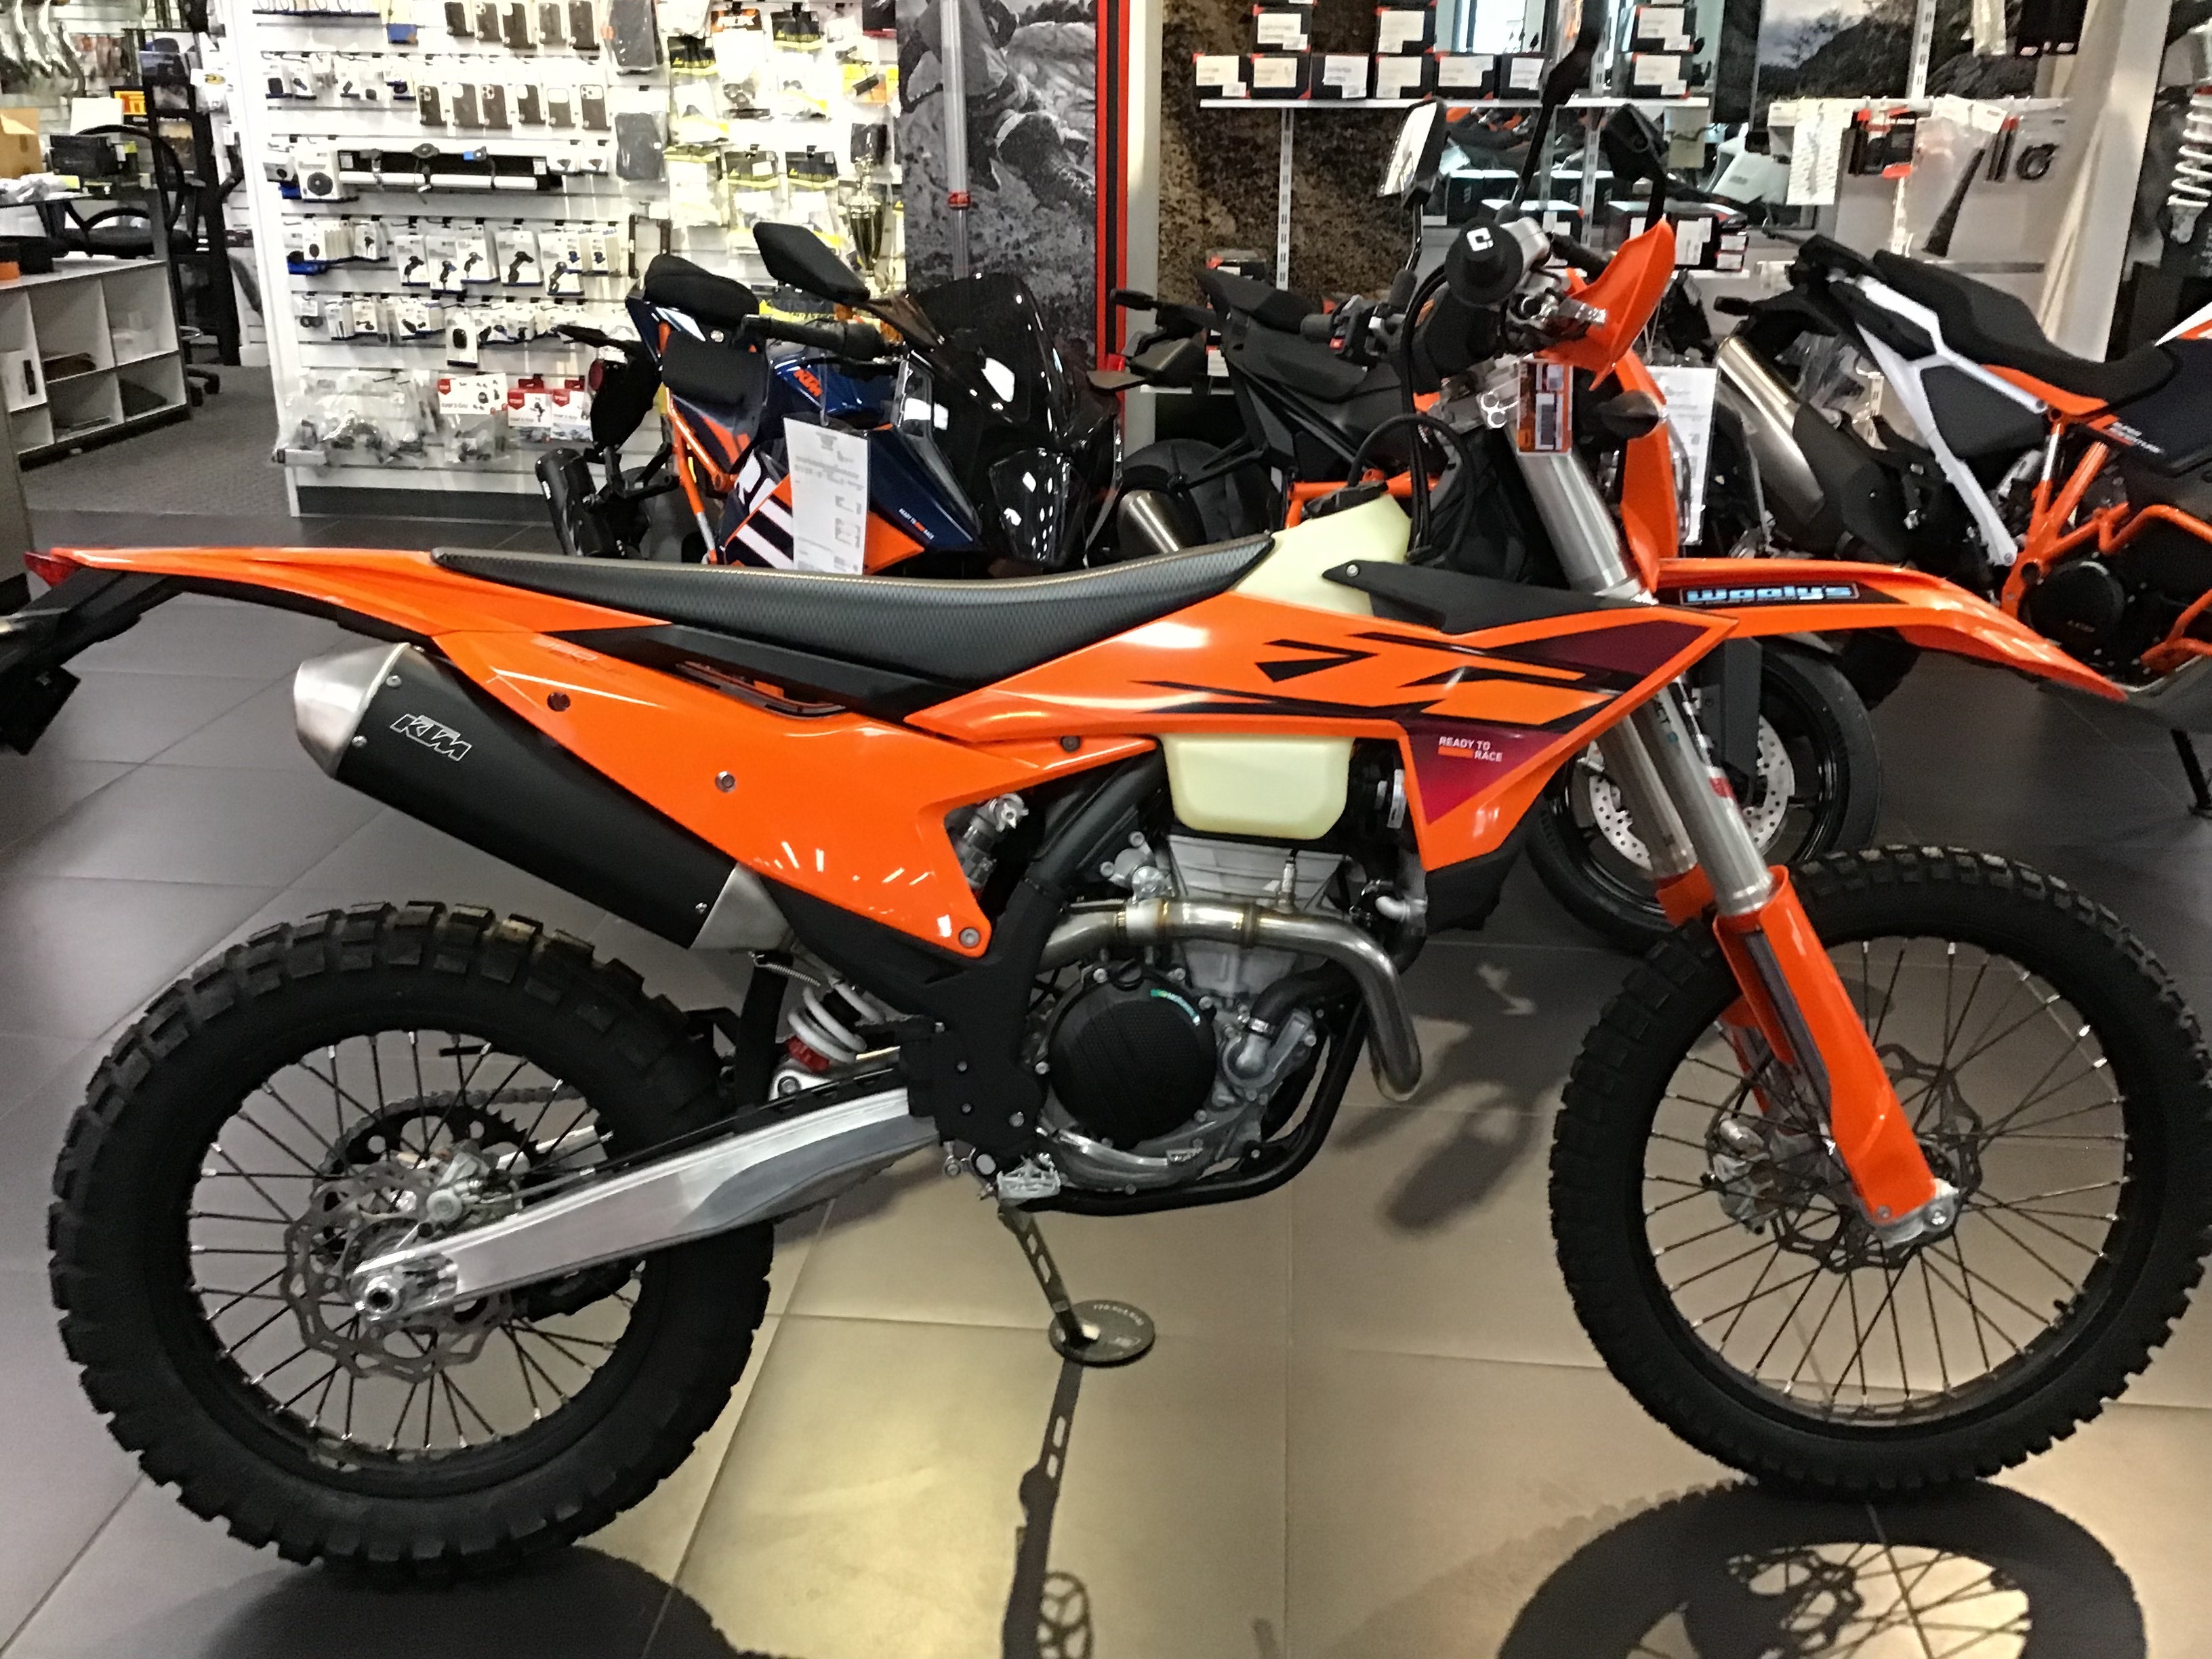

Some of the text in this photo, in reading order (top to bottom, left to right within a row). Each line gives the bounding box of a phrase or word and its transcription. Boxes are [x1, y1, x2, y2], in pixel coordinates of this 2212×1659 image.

[390, 714, 472, 761] KTM
[1439, 736, 1491, 751] READY TO
[1474, 750, 1503, 762] RACE
